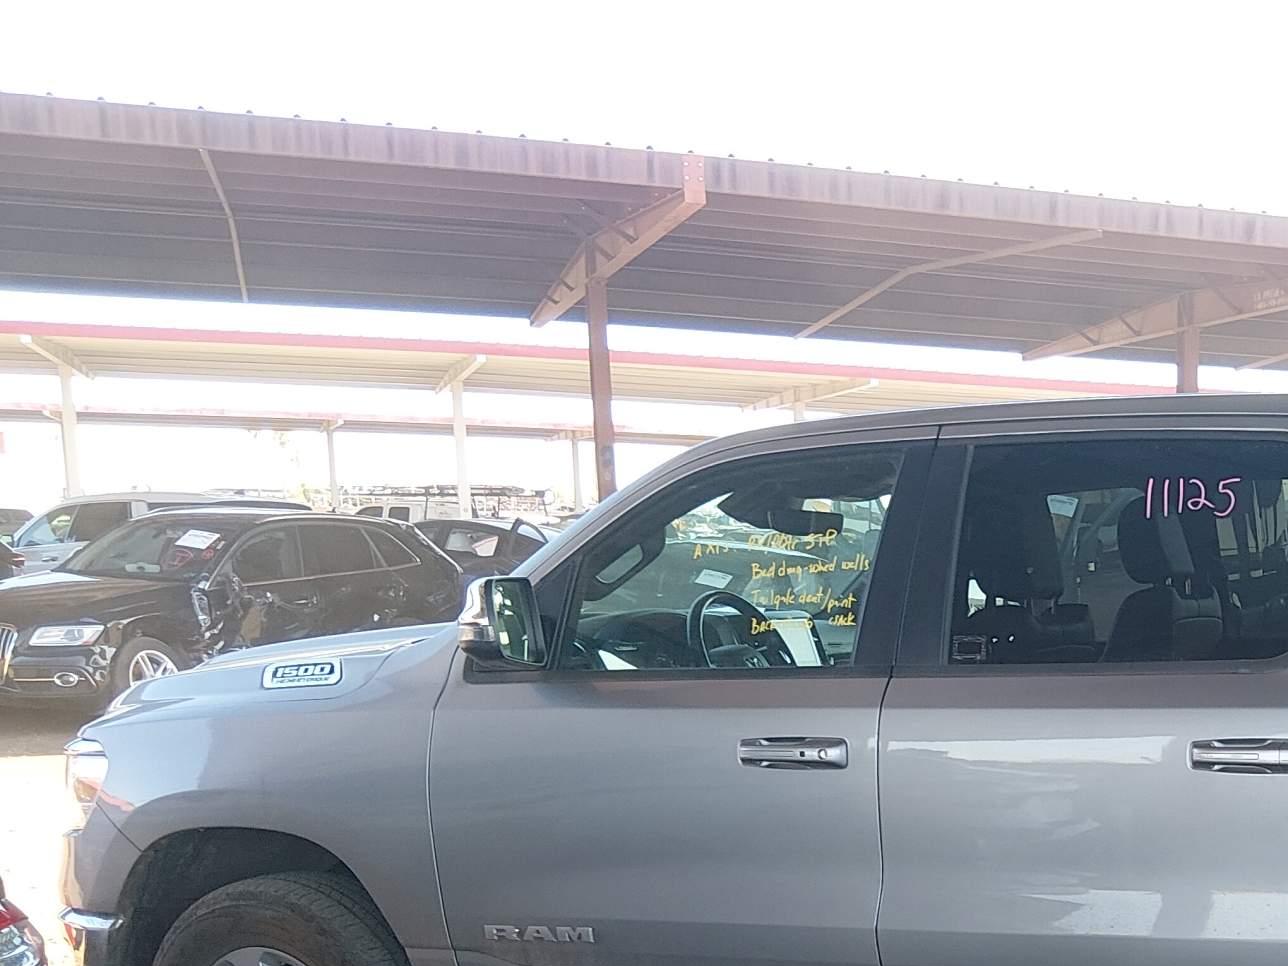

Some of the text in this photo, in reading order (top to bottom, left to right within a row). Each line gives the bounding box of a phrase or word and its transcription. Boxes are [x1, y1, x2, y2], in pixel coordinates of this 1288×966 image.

[1145, 477, 1241, 519] 11125
[275, 664, 333, 678] 1500
[484, 924, 595, 943] RAM
